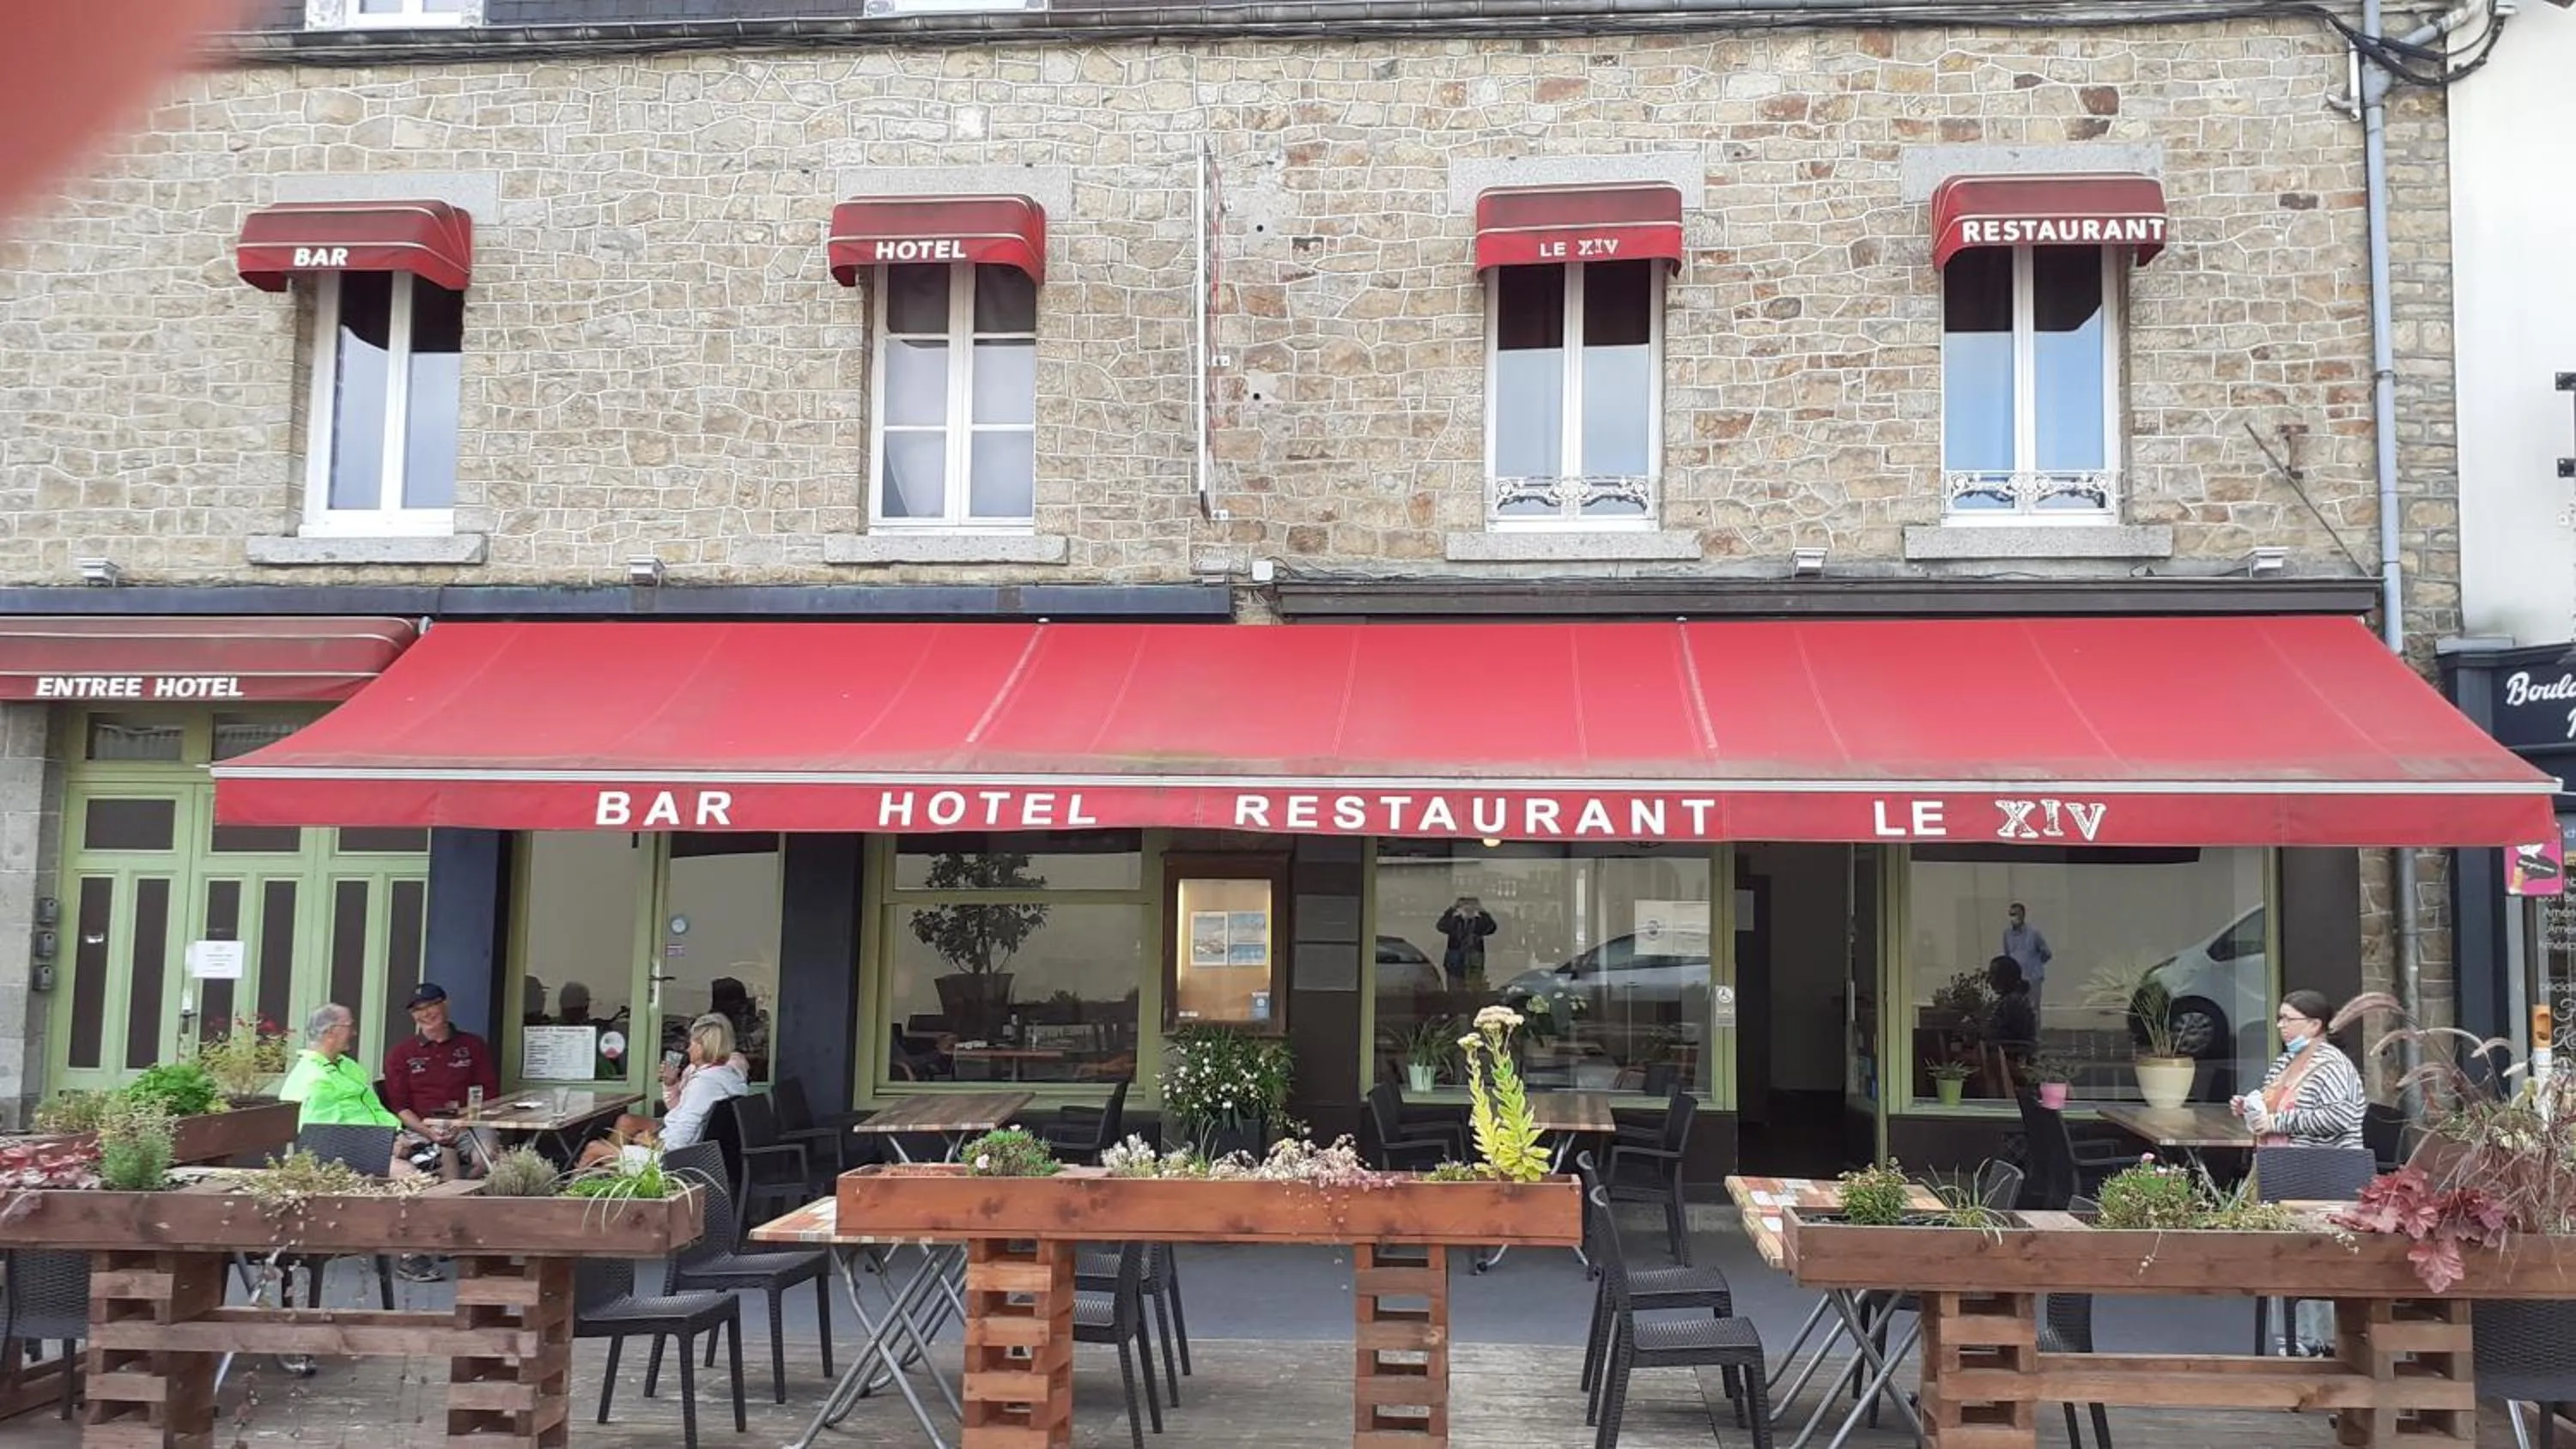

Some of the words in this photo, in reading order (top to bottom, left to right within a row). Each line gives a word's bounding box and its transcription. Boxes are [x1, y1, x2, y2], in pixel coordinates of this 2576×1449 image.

[1961, 218, 2165, 243] RESTAURANT
[293, 246, 349, 267] BAR
[875, 239, 967, 260] HOTEL
[1540, 241, 1567, 257] LE
[1577, 238, 1619, 256] XIV
[34, 676, 143, 697] ENTREE
[153, 676, 245, 697] HOTEL
[594, 790, 733, 826] BAR
[878, 791, 1098, 827] HOTEL
[1234, 794, 1716, 835] RESTAURANT
[1873, 800, 1947, 835] LE
[1995, 798, 2107, 841] XIV
